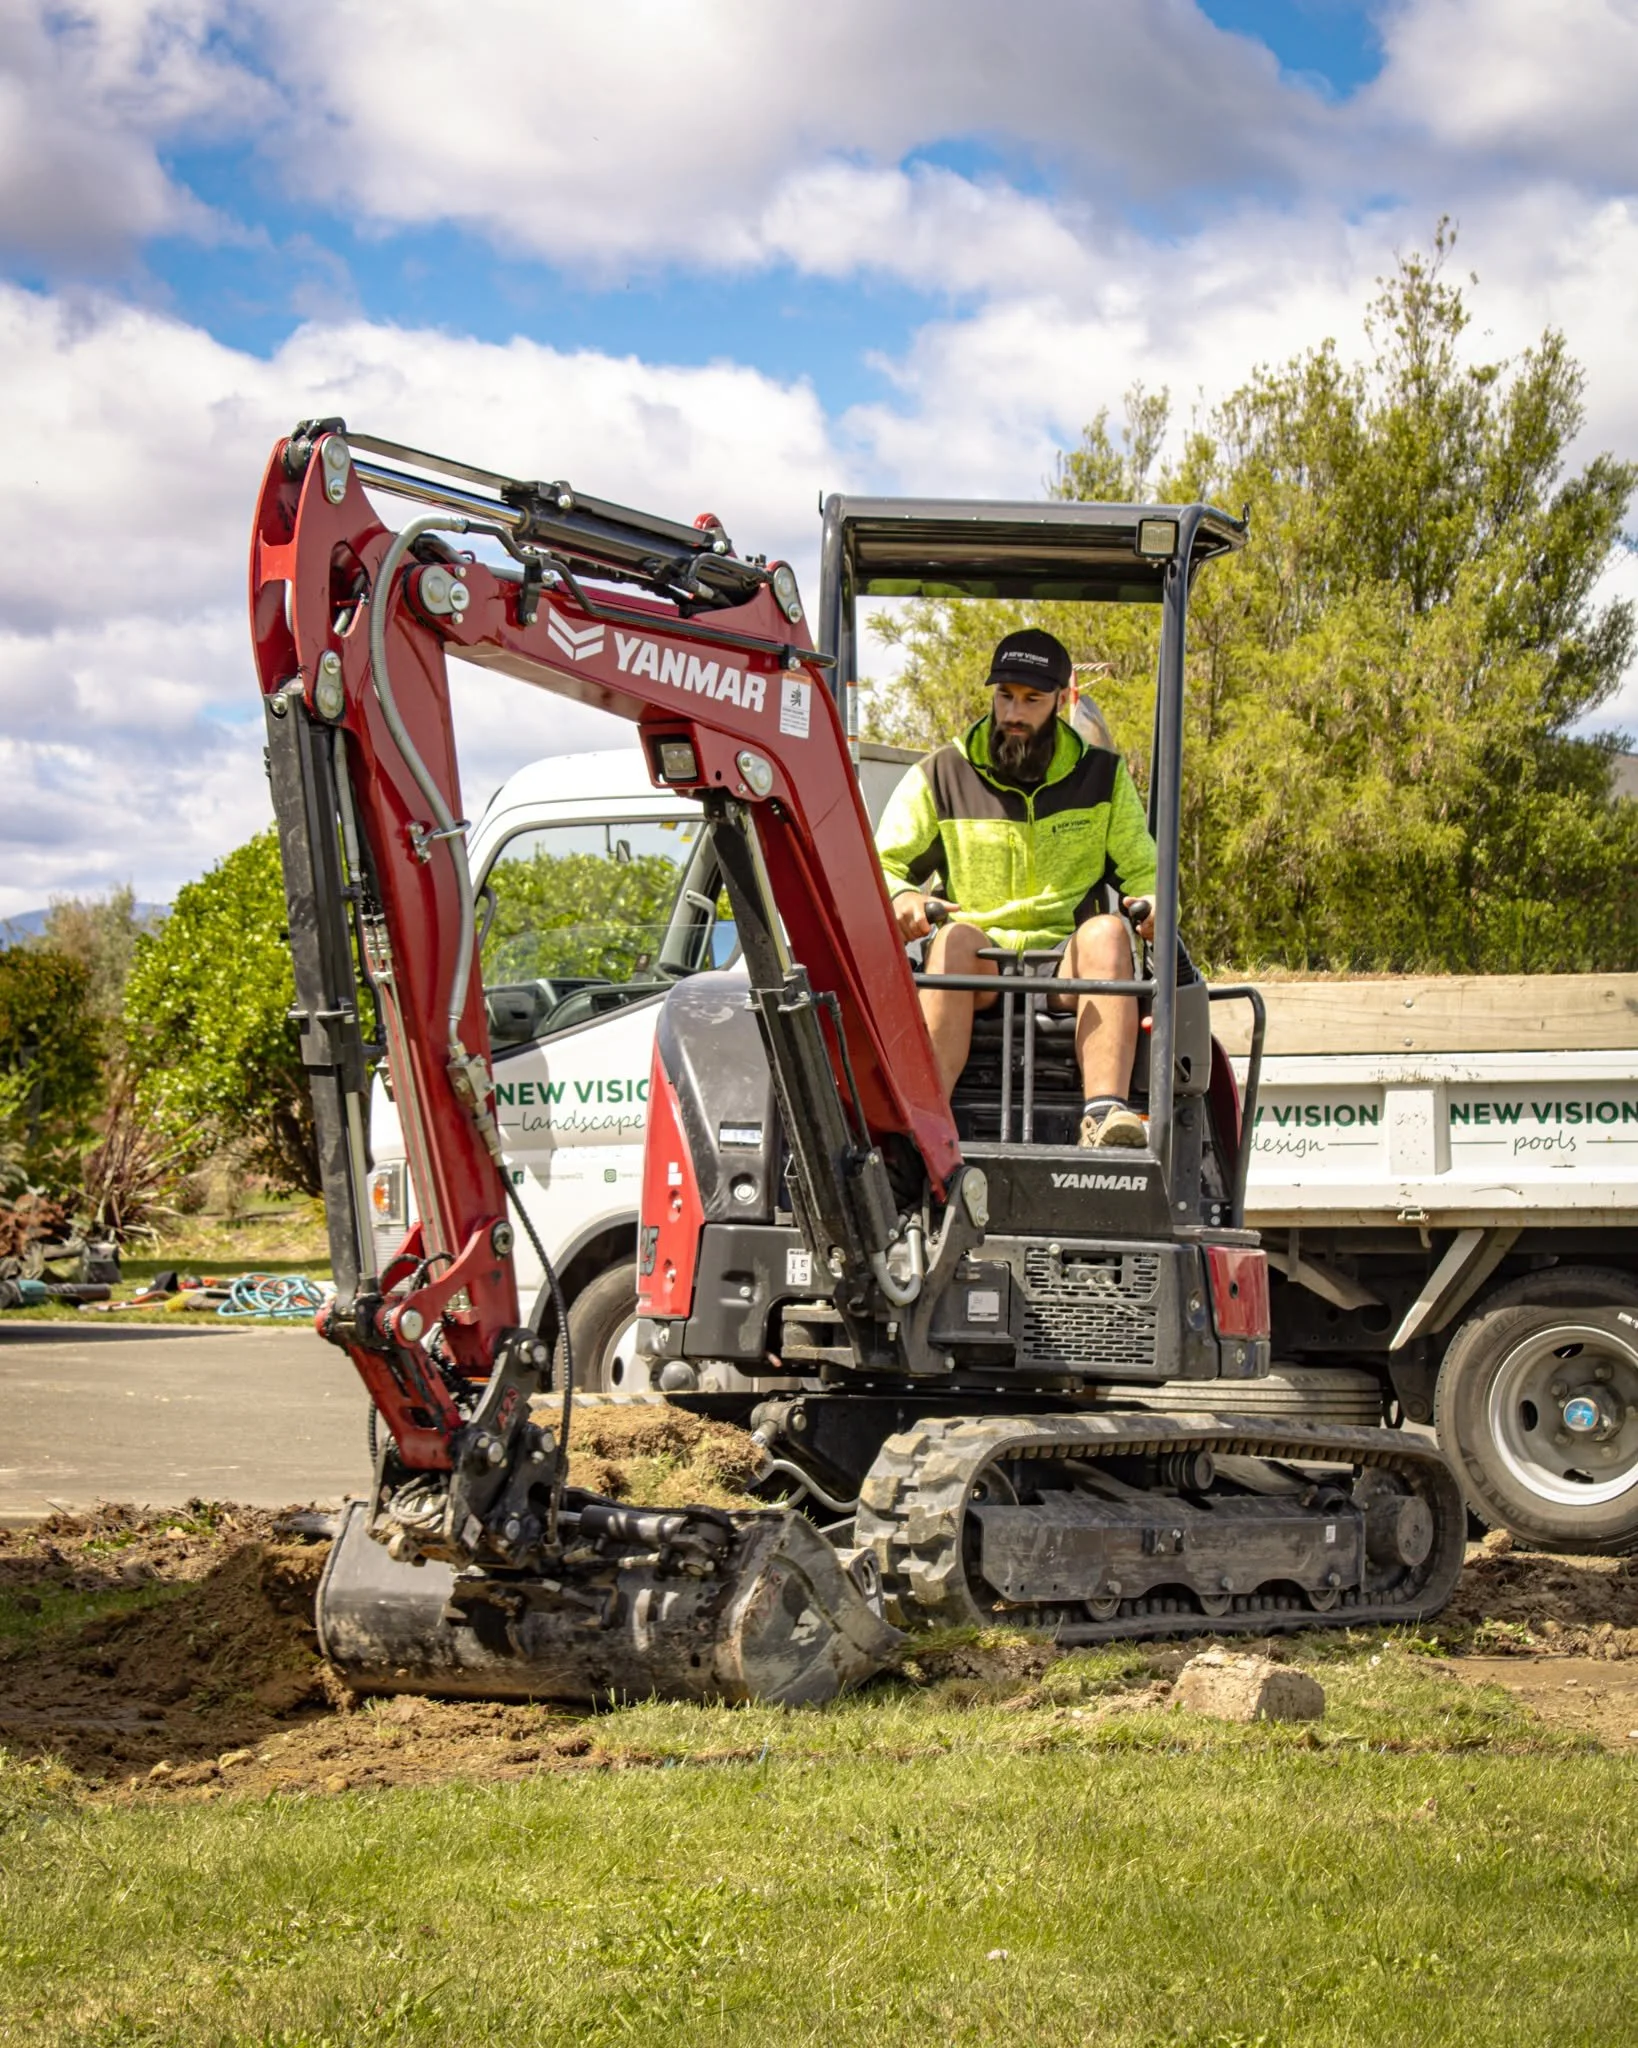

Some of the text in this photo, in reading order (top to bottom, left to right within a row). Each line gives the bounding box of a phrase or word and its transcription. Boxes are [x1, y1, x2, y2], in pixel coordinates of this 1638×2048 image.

[614, 631, 767, 713] YANMAR
[496, 1079, 648, 1105] NEW VISIO
[1271, 1104, 1378, 1128] VISION
[1450, 1101, 1638, 1125] NEW VISION
[1513, 1130, 1577, 1156] pools
[1051, 1173, 1148, 1191] YANMAR
